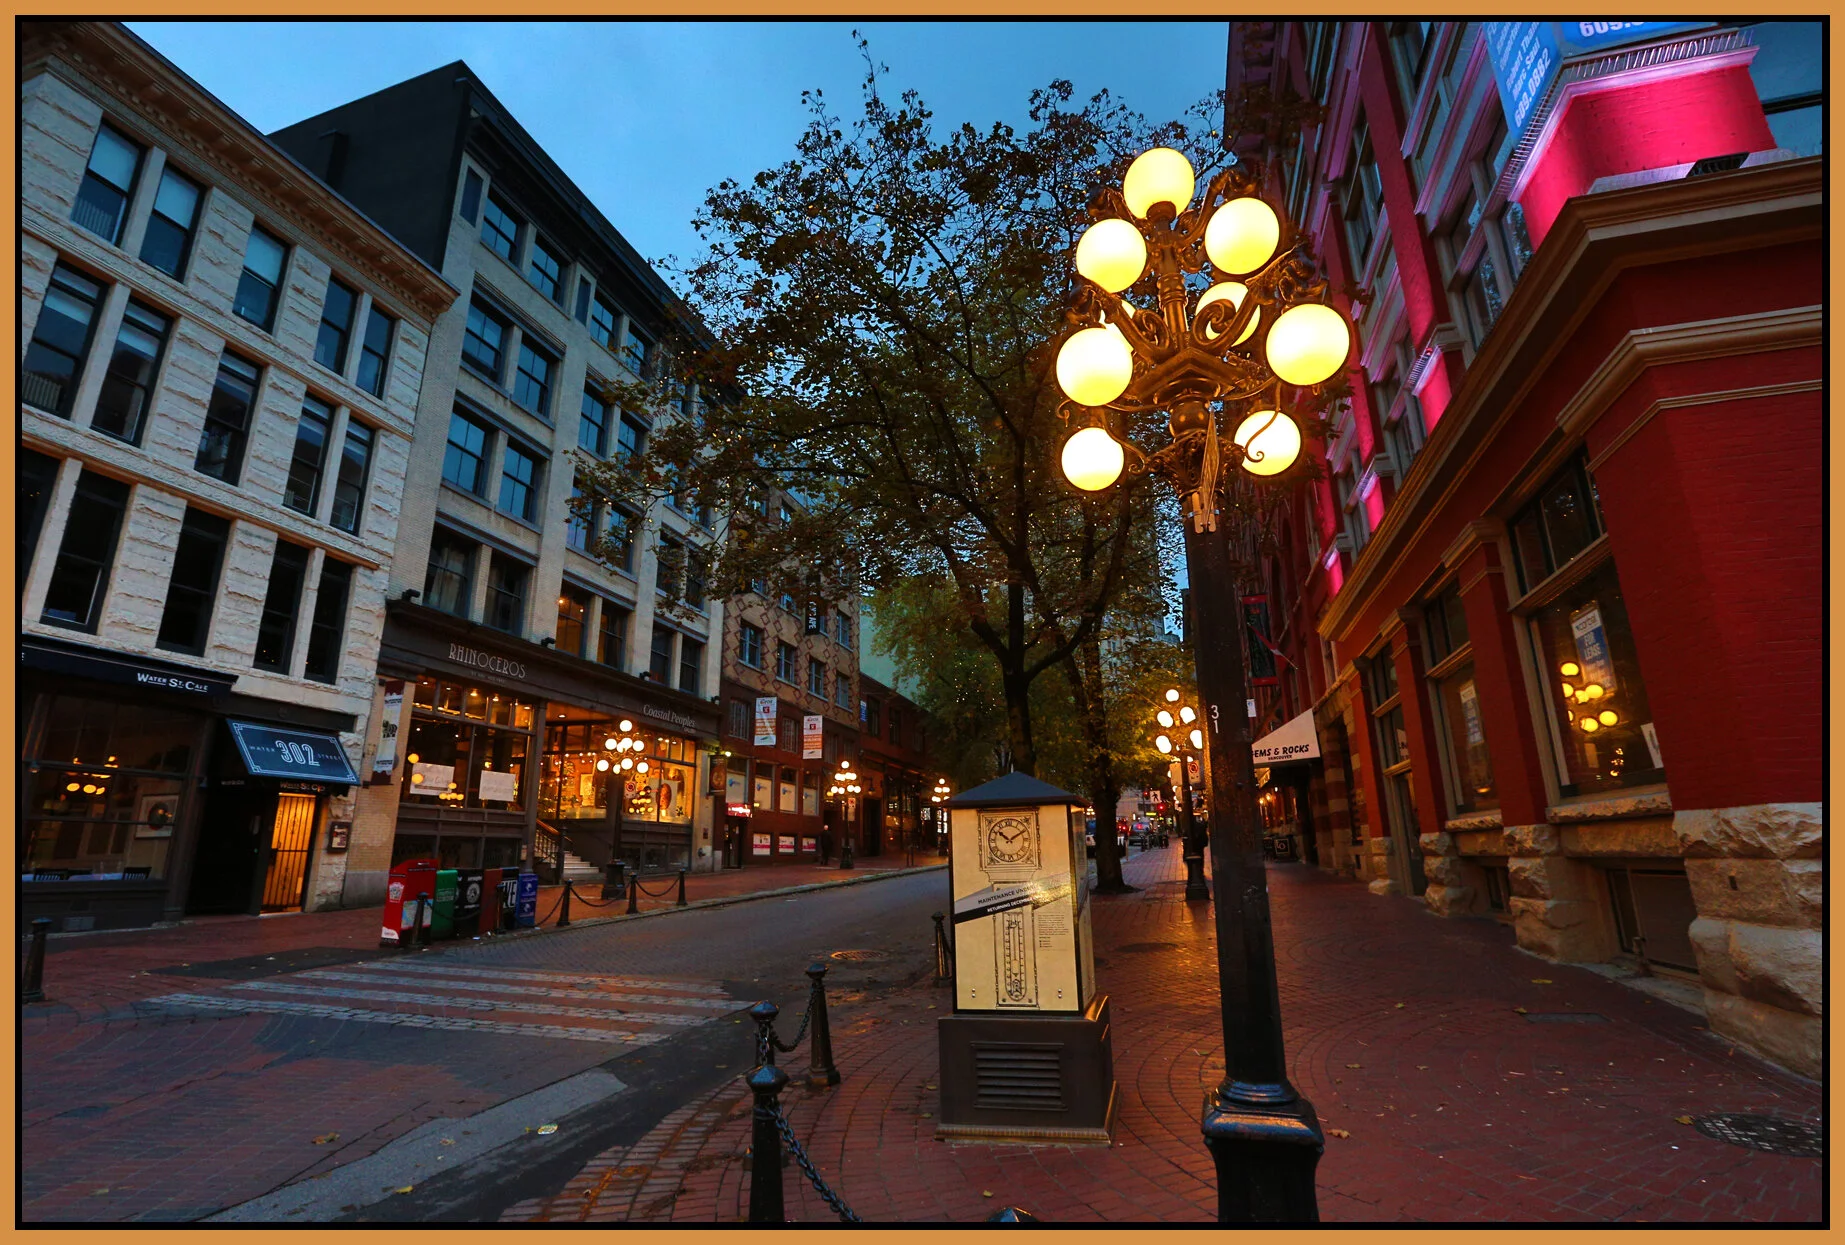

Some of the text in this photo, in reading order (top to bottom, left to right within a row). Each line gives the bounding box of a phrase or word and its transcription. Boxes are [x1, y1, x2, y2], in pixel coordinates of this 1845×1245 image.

[1525, 37, 1541, 70] Saul
[1514, 47, 1551, 128] 609.0882
[448, 643, 526, 679] RHINOCEROS
[137, 673, 167, 686] WATER
[185, 681, 209, 692] CAFE
[643, 704, 696, 728] Coastal Peoples
[250, 745, 276, 753] WATER
[275, 740, 321, 766] 302
[1252, 748, 1272, 758] EMS
[1282, 744, 1310, 755] ROCKS
[978, 890, 1015, 905] MAINTENANCE
[987, 901, 1011, 913] RETURNING
